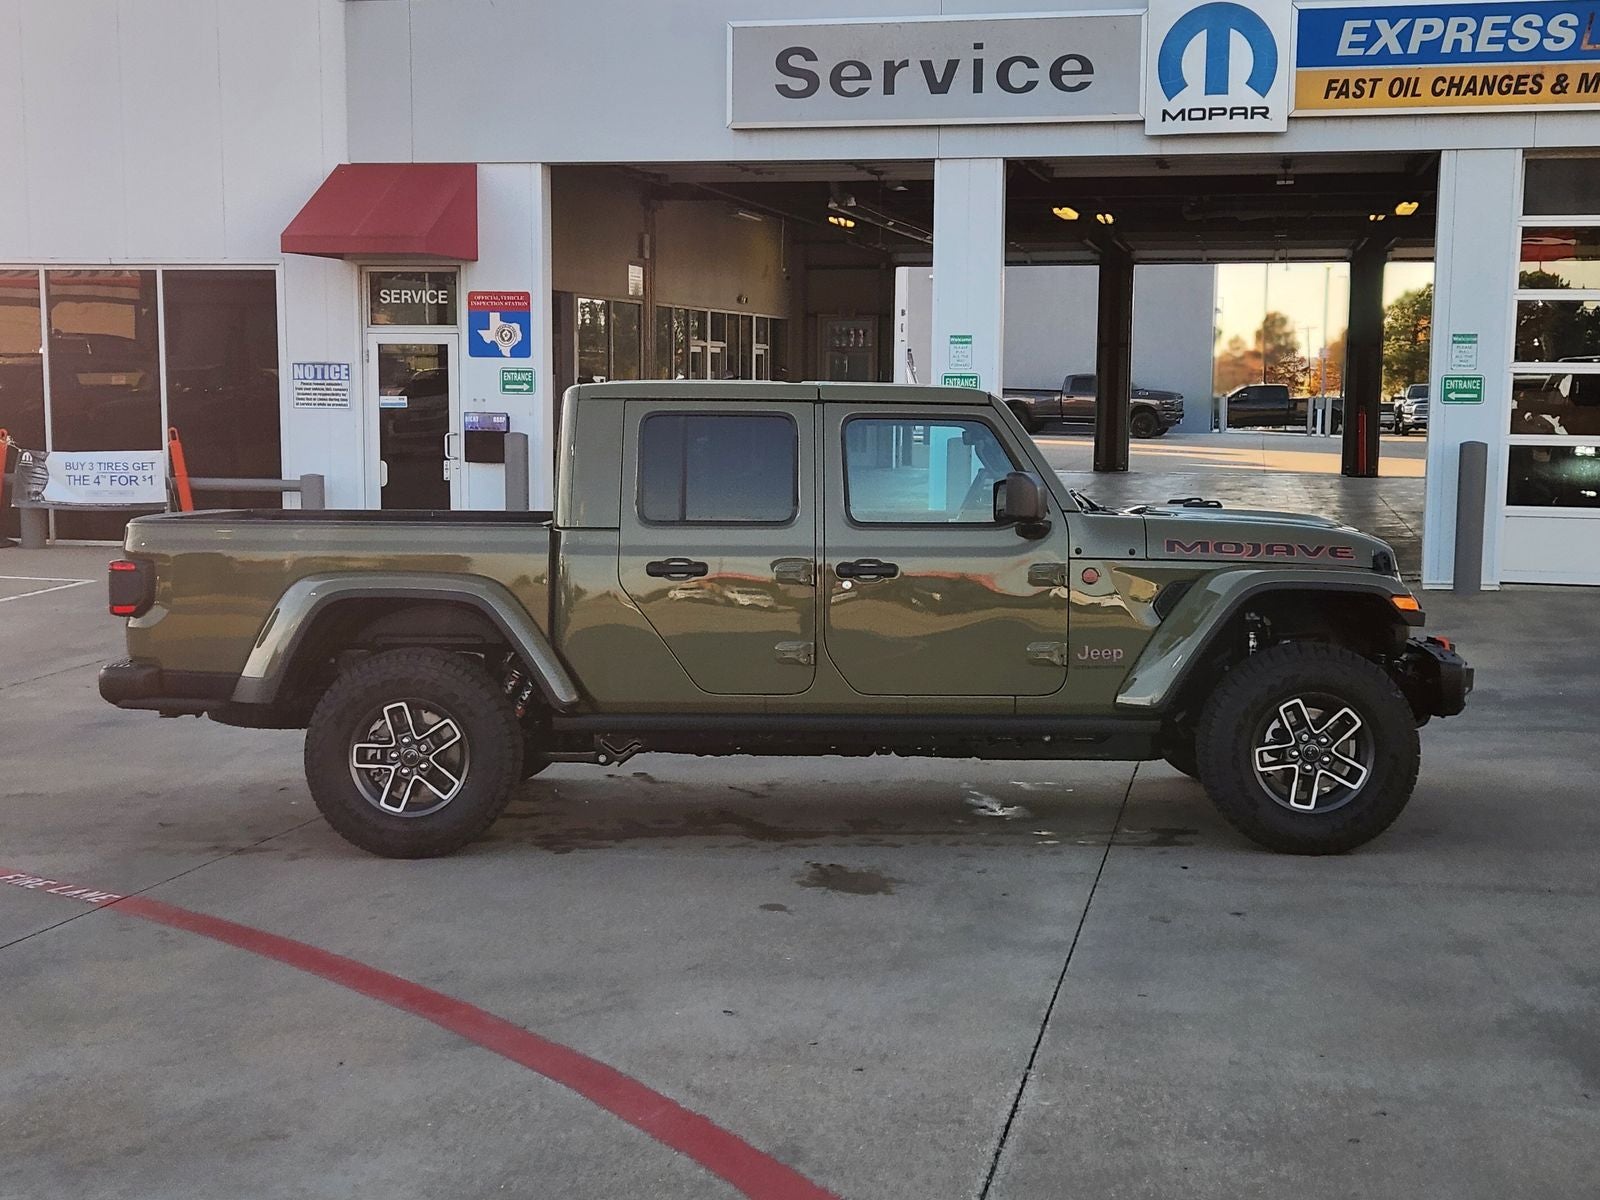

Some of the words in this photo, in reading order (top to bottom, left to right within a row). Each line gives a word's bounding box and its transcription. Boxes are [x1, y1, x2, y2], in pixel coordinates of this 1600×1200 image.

[1336, 13, 1580, 57] EXPRESS
[774, 42, 1095, 100] Service
[1323, 77, 1384, 100] FAST
[1388, 76, 1422, 99] OIL
[1431, 73, 1545, 97] CHANGES
[1551, 73, 1568, 95] &
[1161, 106, 1271, 123] MOPAR
[379, 289, 449, 304] SERVICE
[293, 364, 349, 380] NOTICE
[503, 371, 532, 381] ENTRANCE
[945, 377, 977, 387] ENTRANCE
[1445, 379, 1481, 390] ENTRANCE
[65, 461, 87, 471] BUY
[88, 461, 94, 471] 3
[97, 461, 129, 471] TIRES
[132, 461, 156, 471] GET
[66, 475, 91, 486] THE
[110, 475, 139, 486] FOR
[1165, 538, 1356, 560] MOJAVE
[1077, 645, 1124, 662] Jeep
[0, 873, 58, 889] FIRE
[46, 884, 121, 903] LANE
